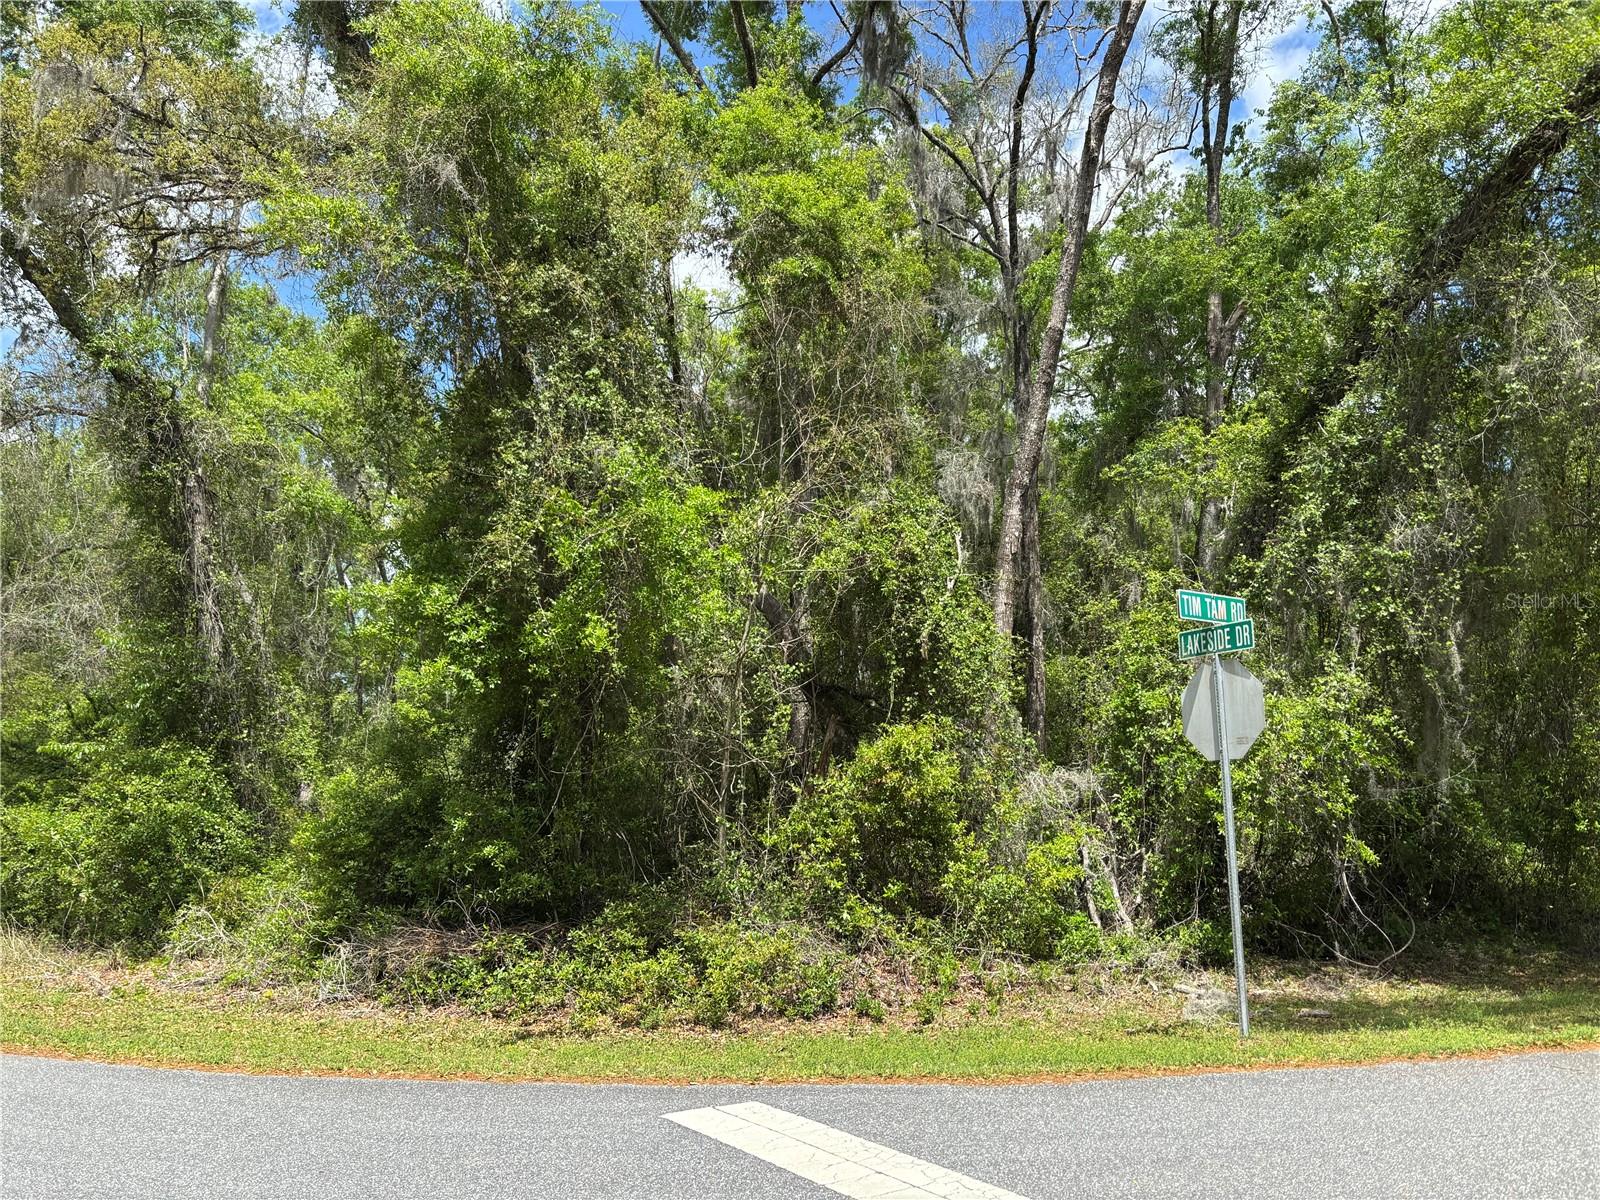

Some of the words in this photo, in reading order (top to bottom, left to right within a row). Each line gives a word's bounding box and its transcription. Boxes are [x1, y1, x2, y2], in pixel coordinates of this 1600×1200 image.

[1181, 594, 1202, 617] TIM
[1205, 597, 1227, 621] TAM
[1230, 601, 1244, 622] RD
[1181, 627, 1232, 656] LAKESIDE
[1235, 624, 1251, 647] DR
